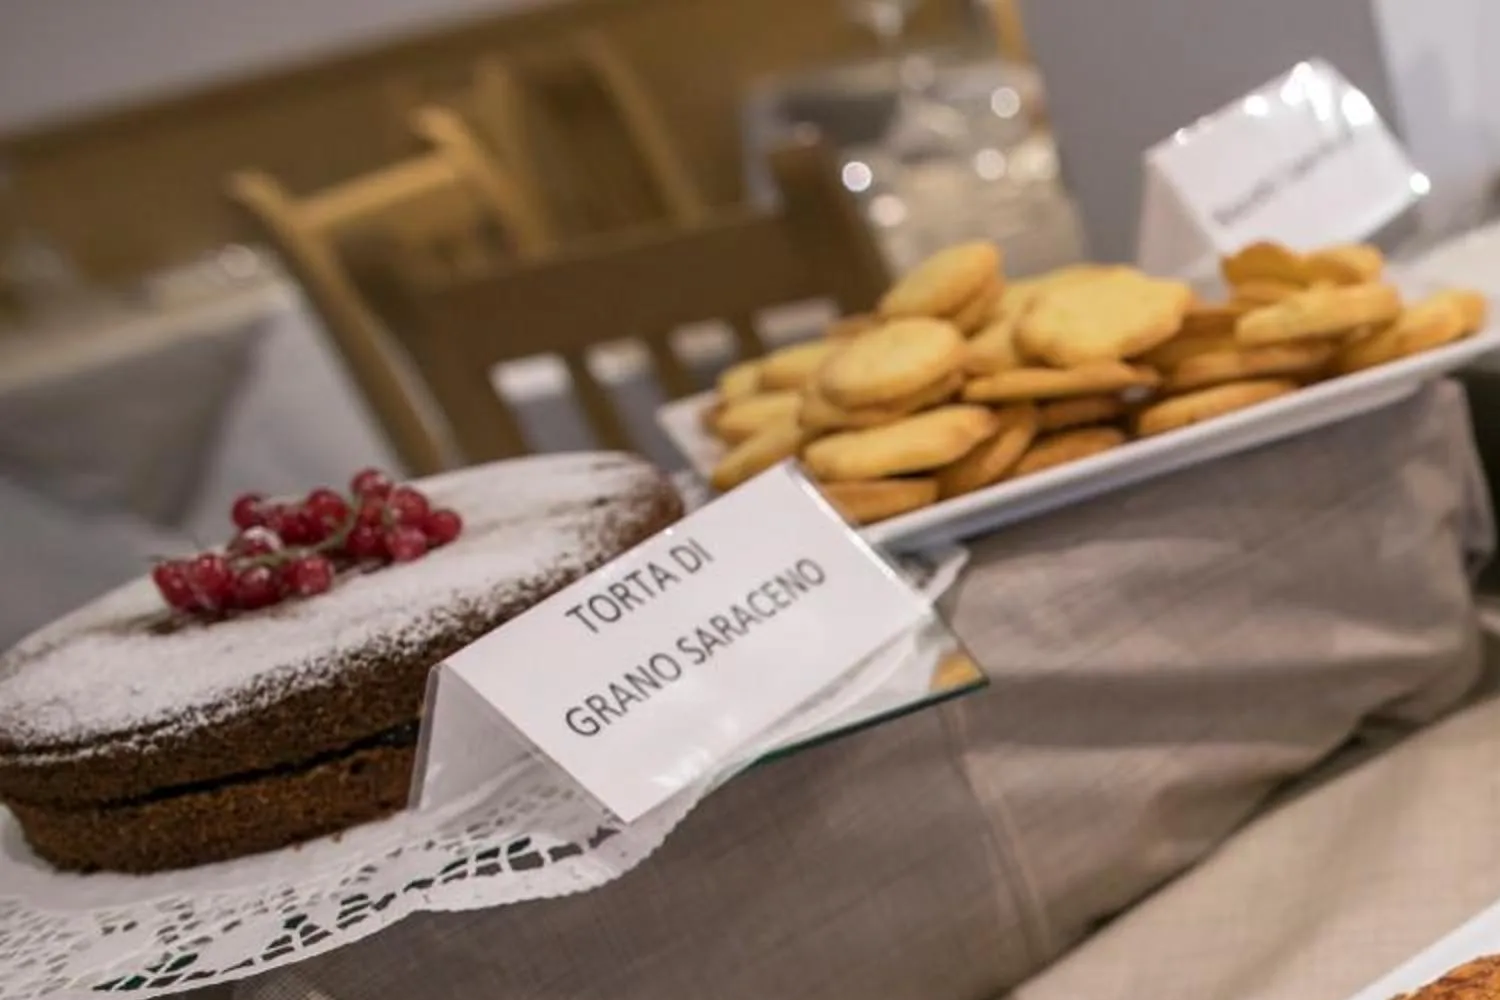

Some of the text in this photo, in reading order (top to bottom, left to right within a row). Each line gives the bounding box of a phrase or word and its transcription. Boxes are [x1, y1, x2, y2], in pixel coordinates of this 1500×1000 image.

[564, 536, 715, 634] TORTA DI
[564, 557, 826, 738] GRANO SARACENO
